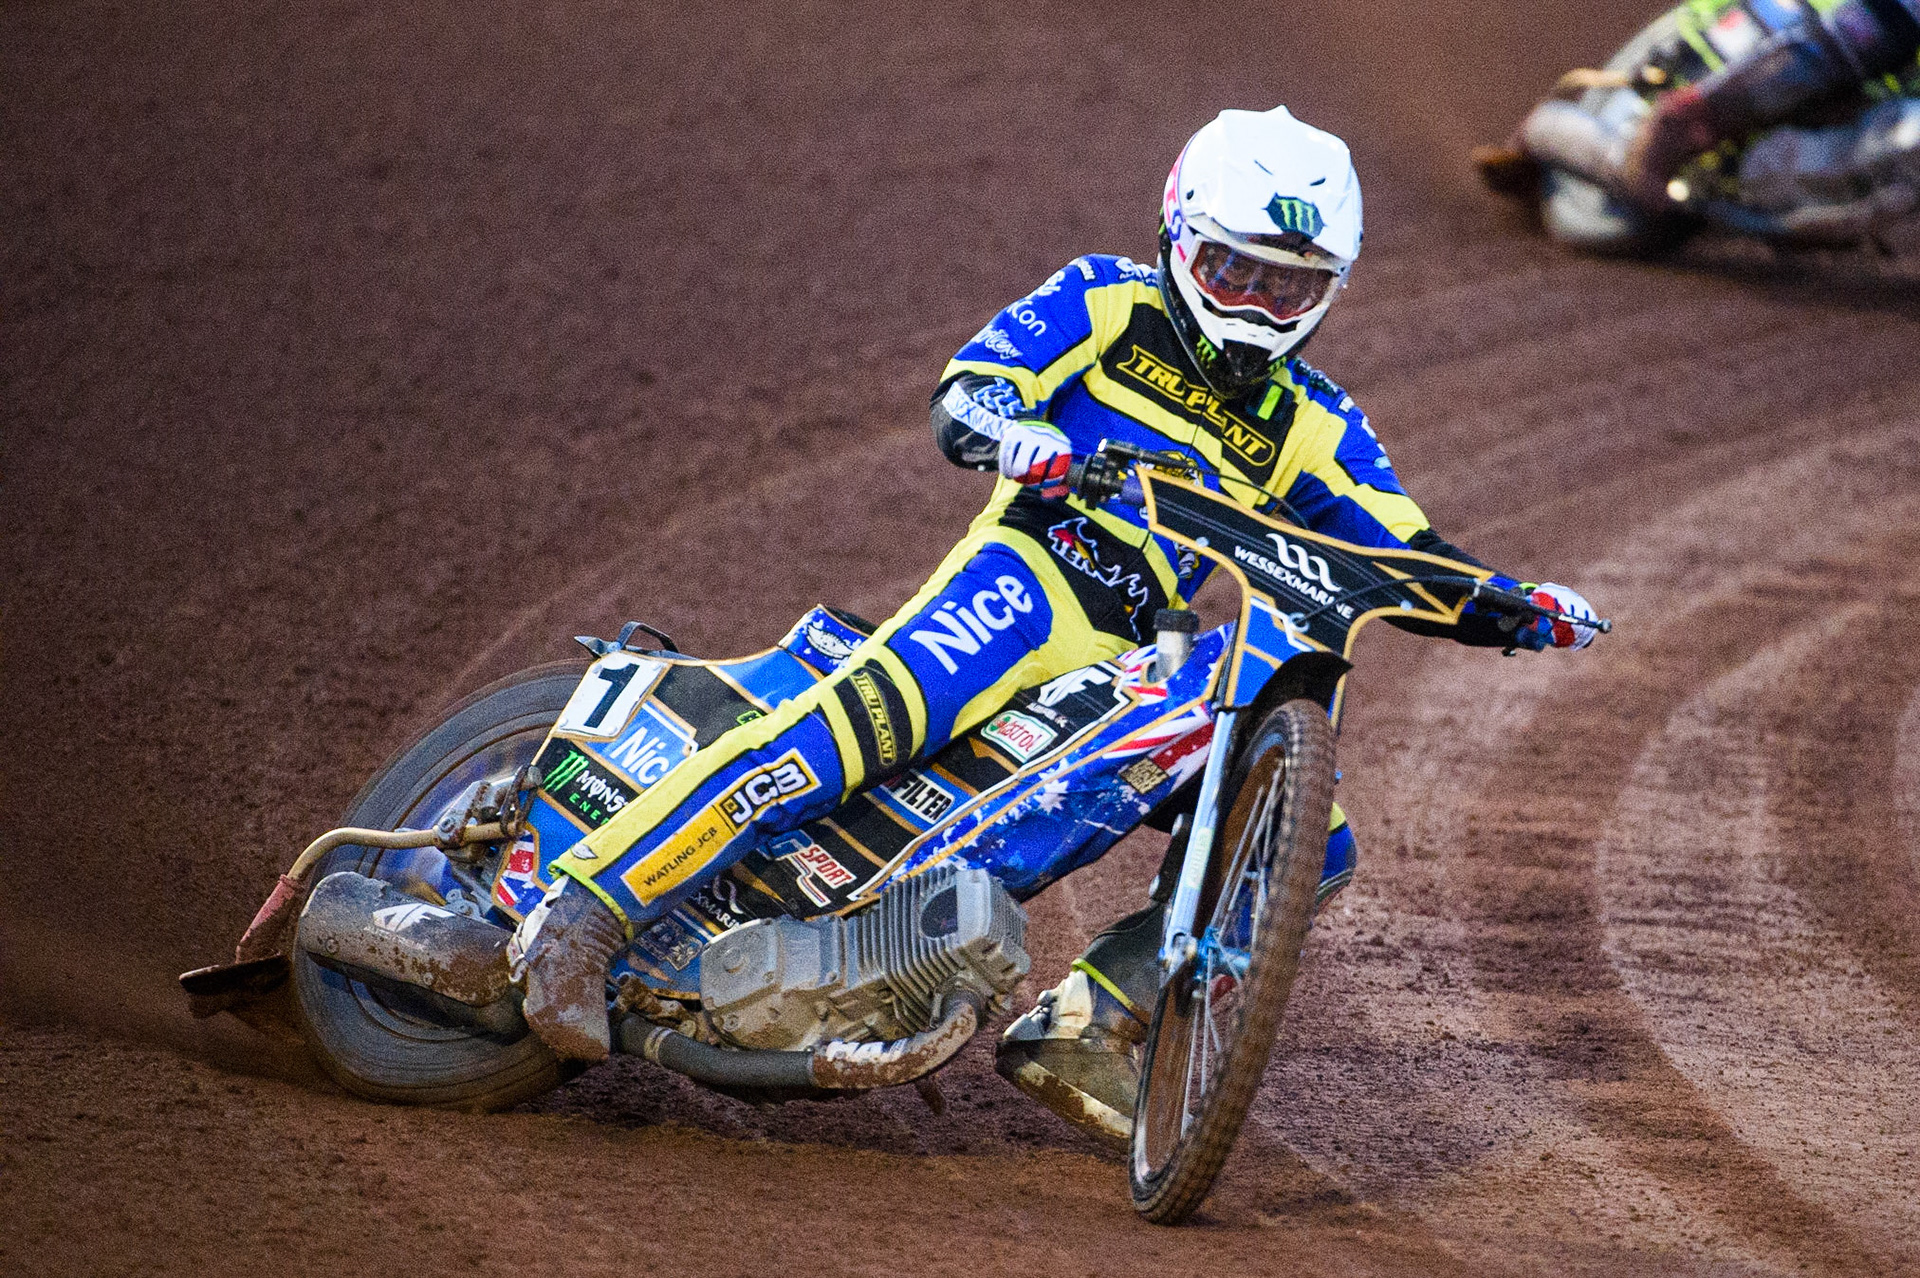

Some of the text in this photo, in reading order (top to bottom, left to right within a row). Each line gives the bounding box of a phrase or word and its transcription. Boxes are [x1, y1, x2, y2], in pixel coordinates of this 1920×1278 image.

[909, 574, 1034, 676] Nice
[583, 662, 641, 729] 1
[609, 726, 670, 785] Nic
[732, 762, 808, 824] JCB
[892, 774, 953, 821] FILTER
[643, 826, 719, 887] WATLING JCB
[799, 845, 853, 887] SPORT
